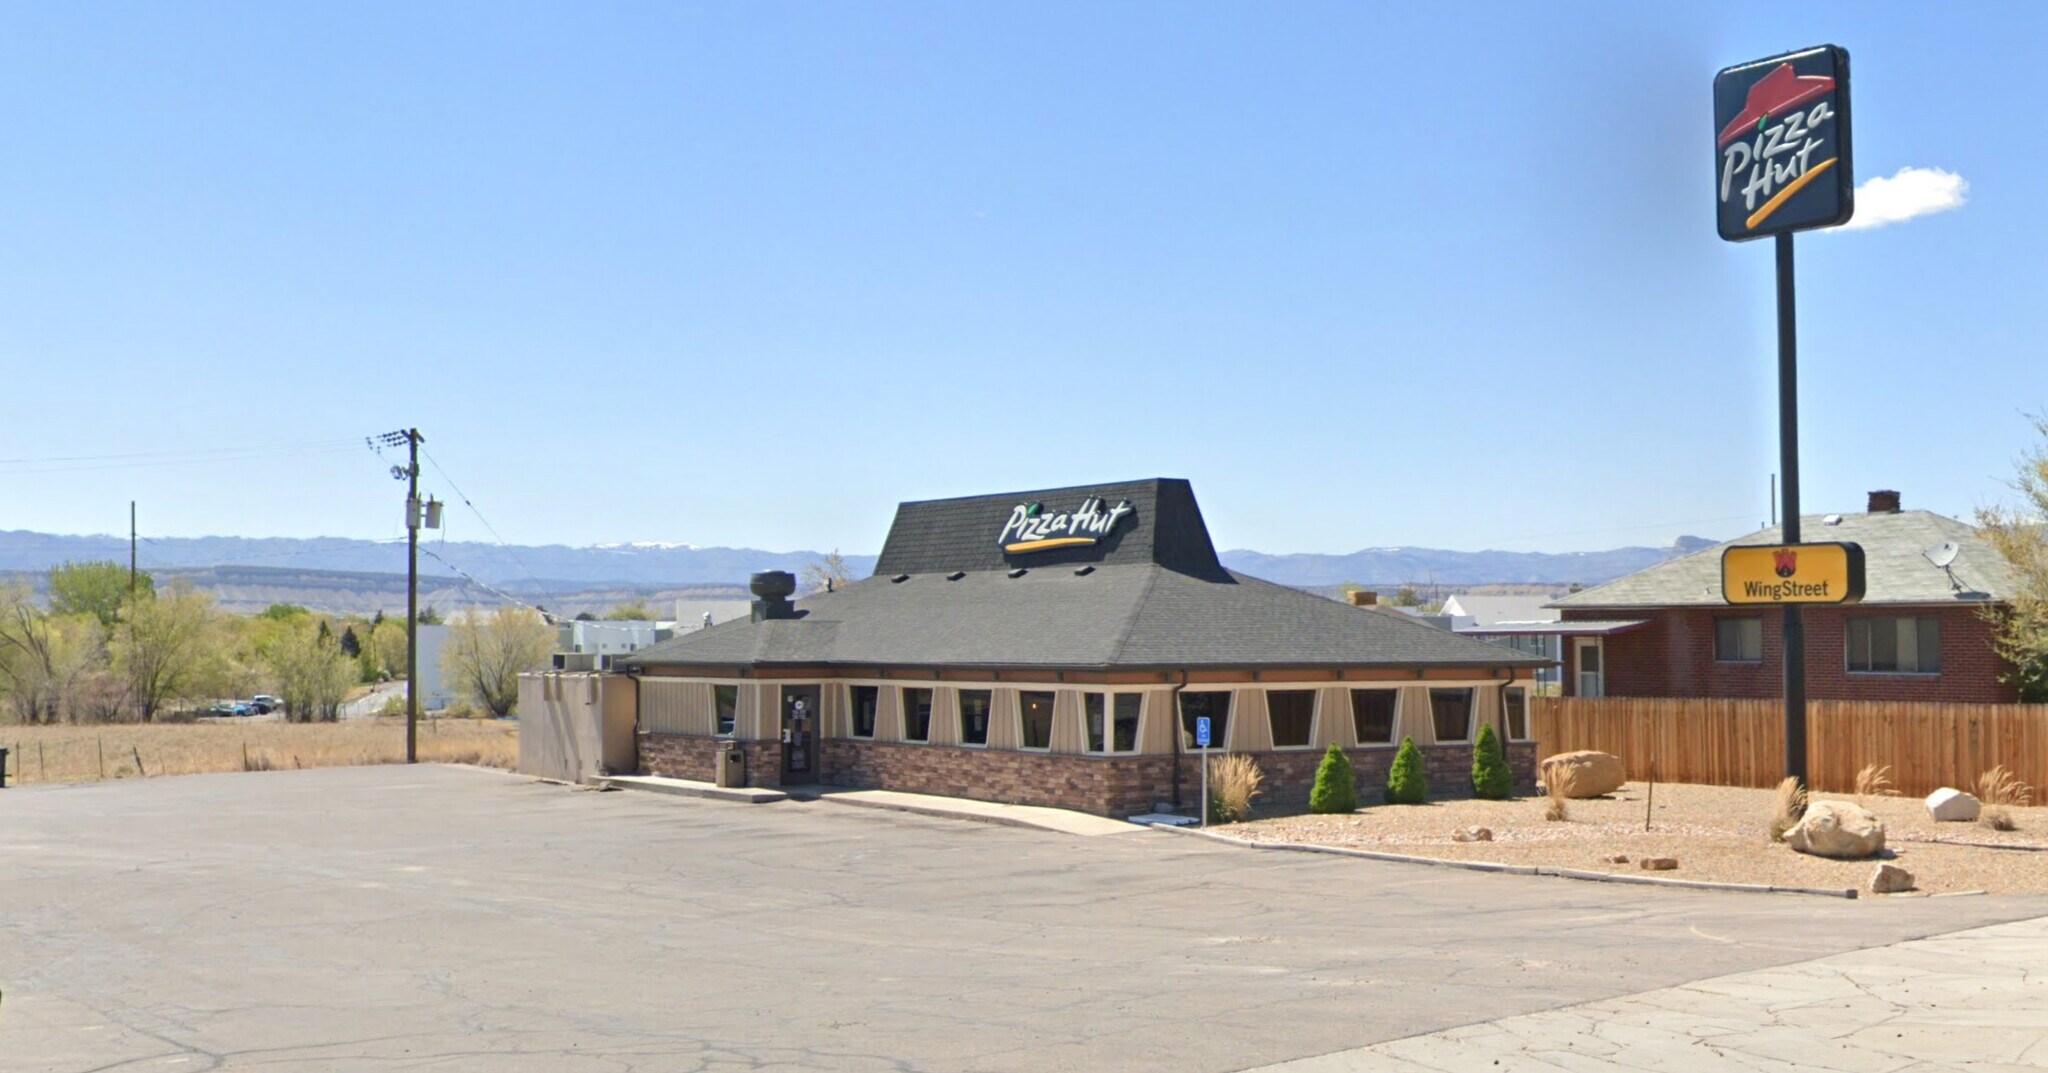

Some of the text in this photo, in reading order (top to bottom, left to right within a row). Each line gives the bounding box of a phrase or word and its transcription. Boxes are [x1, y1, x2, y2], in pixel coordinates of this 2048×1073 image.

[1721, 101, 1835, 202] Pizza
[1741, 137, 1824, 210] Hut
[998, 498, 1132, 544] Pizza Hut
[1744, 580, 1829, 600] WingStreet
